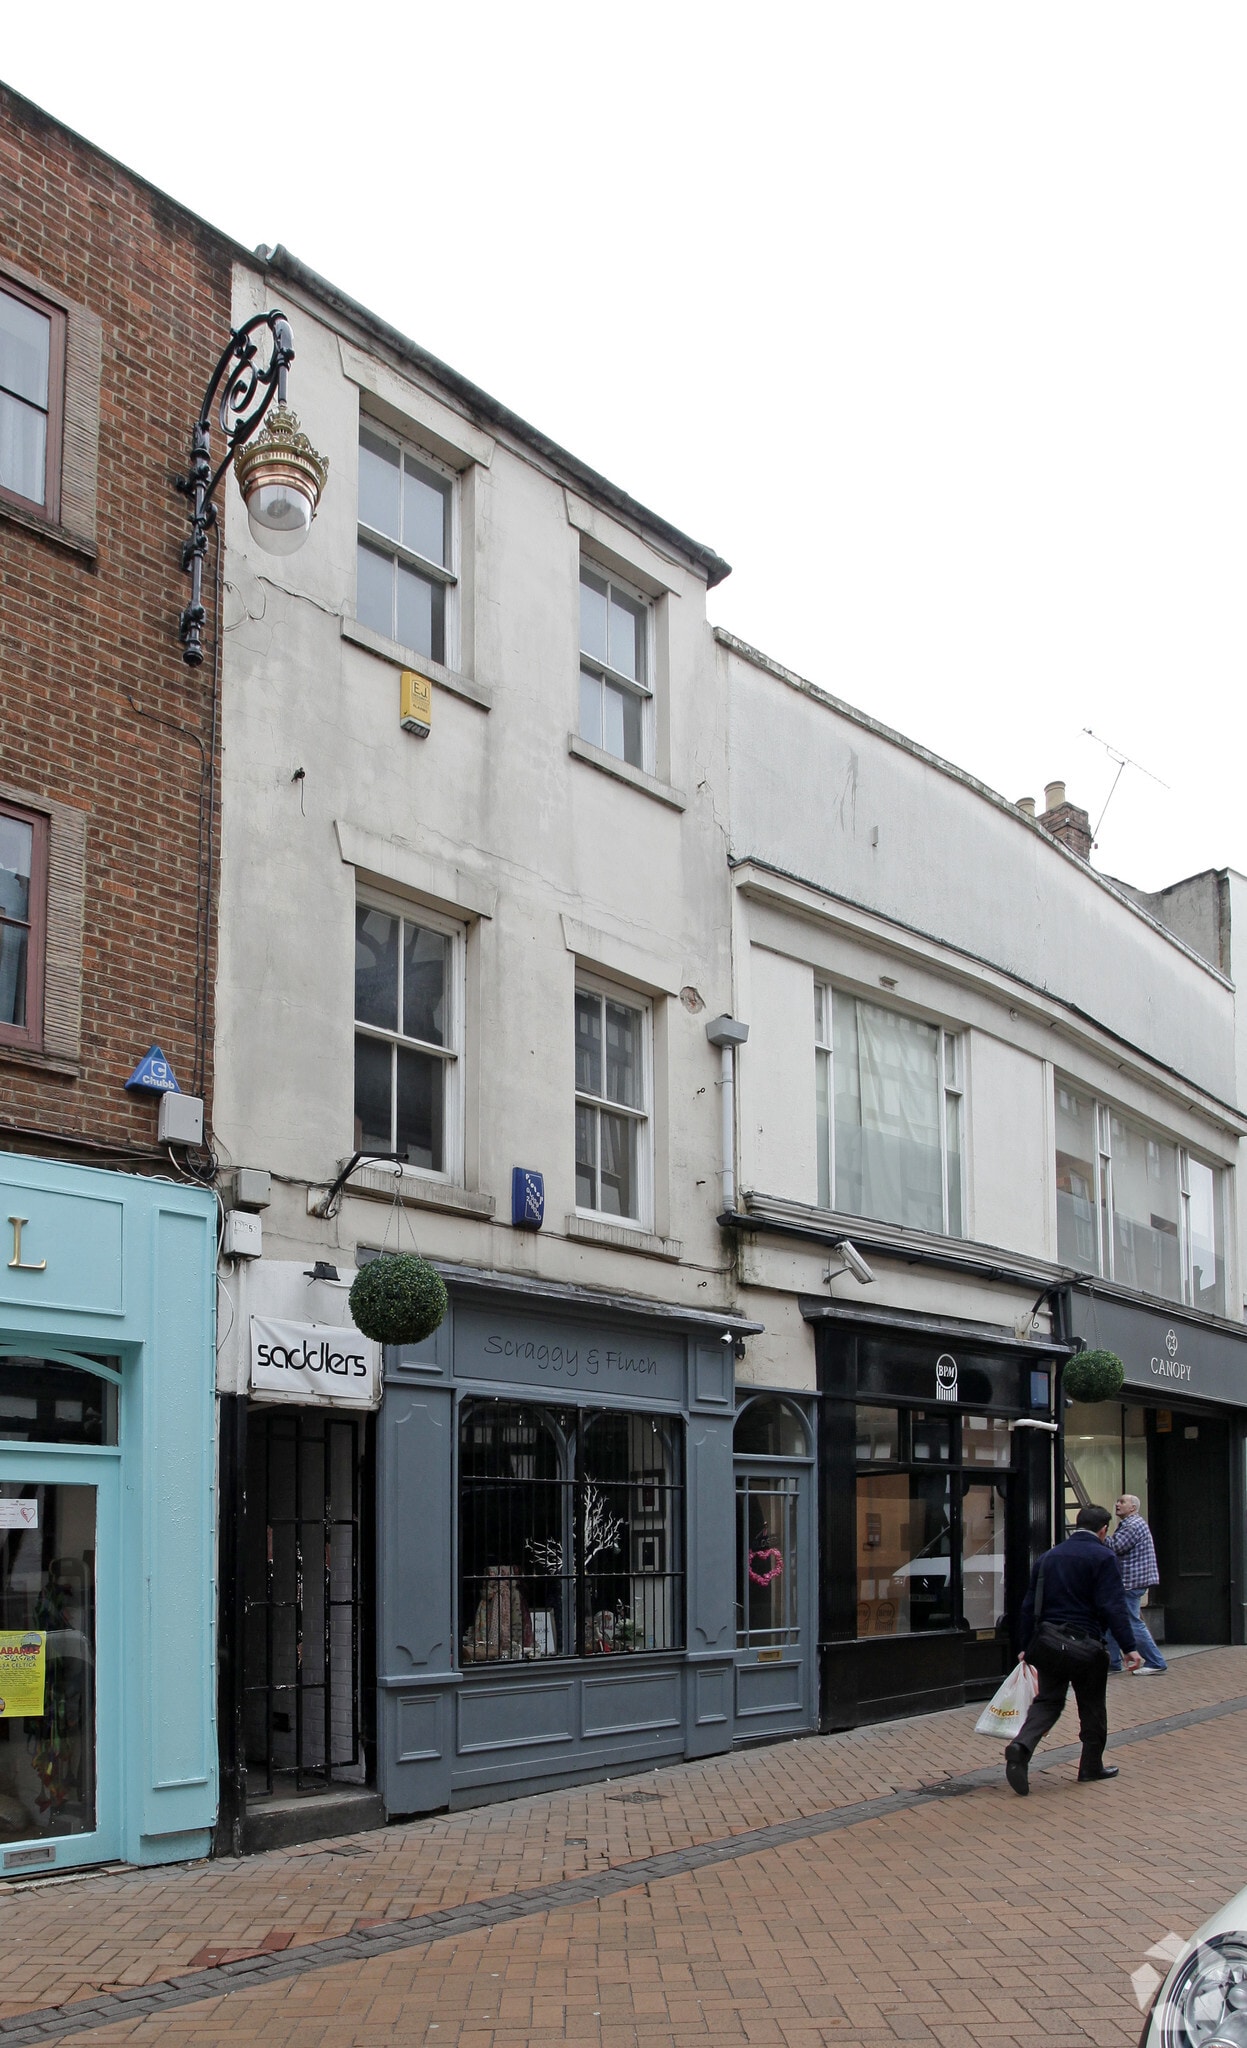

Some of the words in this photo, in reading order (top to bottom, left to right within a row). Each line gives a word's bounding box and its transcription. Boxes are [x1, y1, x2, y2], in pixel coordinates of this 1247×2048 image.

[142, 1075, 175, 1090] Chubb
[7, 1215, 48, 1271] L
[257, 1340, 367, 1377] saddlers
[483, 1335, 579, 1377] Scraggy
[605, 1351, 658, 1376] Finch
[938, 1365, 956, 1378] BPM
[1150, 1356, 1192, 1381] CANOPY
